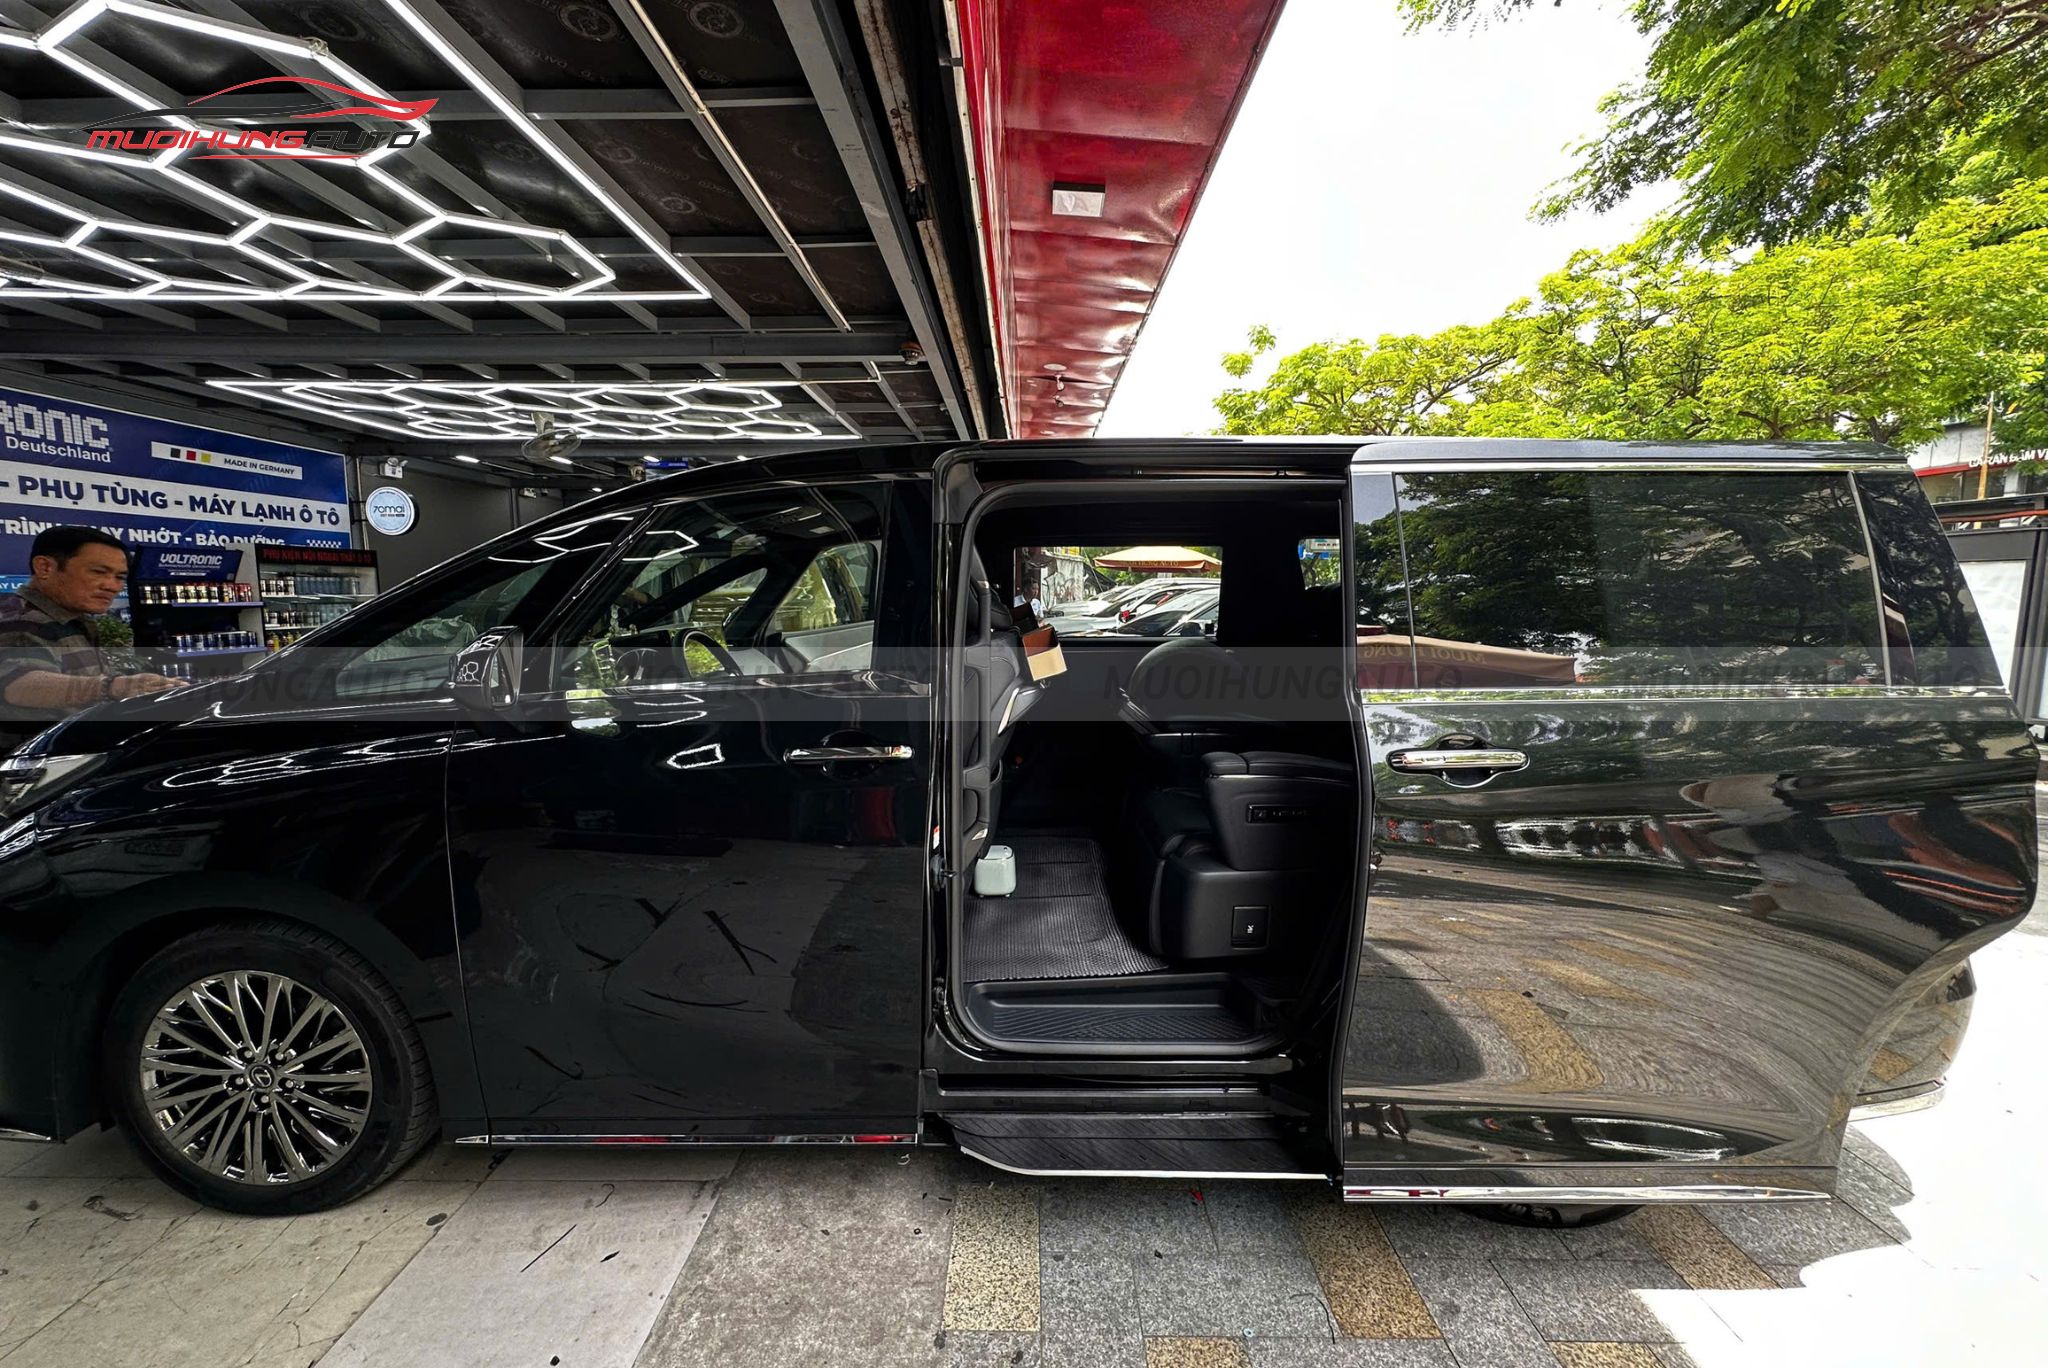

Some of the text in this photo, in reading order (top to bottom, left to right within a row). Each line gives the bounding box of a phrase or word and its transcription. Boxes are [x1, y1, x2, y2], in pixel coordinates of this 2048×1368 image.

[6, 436, 112, 463] Deutschland
[224, 458, 248, 468] MADE
[259, 463, 295, 474] GERMANY
[18, 475, 84, 505] PHỤ
[91, 482, 168, 509] TÙNG
[189, 493, 235, 515] MÁY
[242, 501, 295, 522] LẠNH
[300, 504, 312, 523] Ô
[317, 507, 340, 525] TÔ
[128, 527, 182, 544] NHỚT
[195, 530, 230, 546] BẢO
[160, 553, 223, 565] VOLTRONIC
